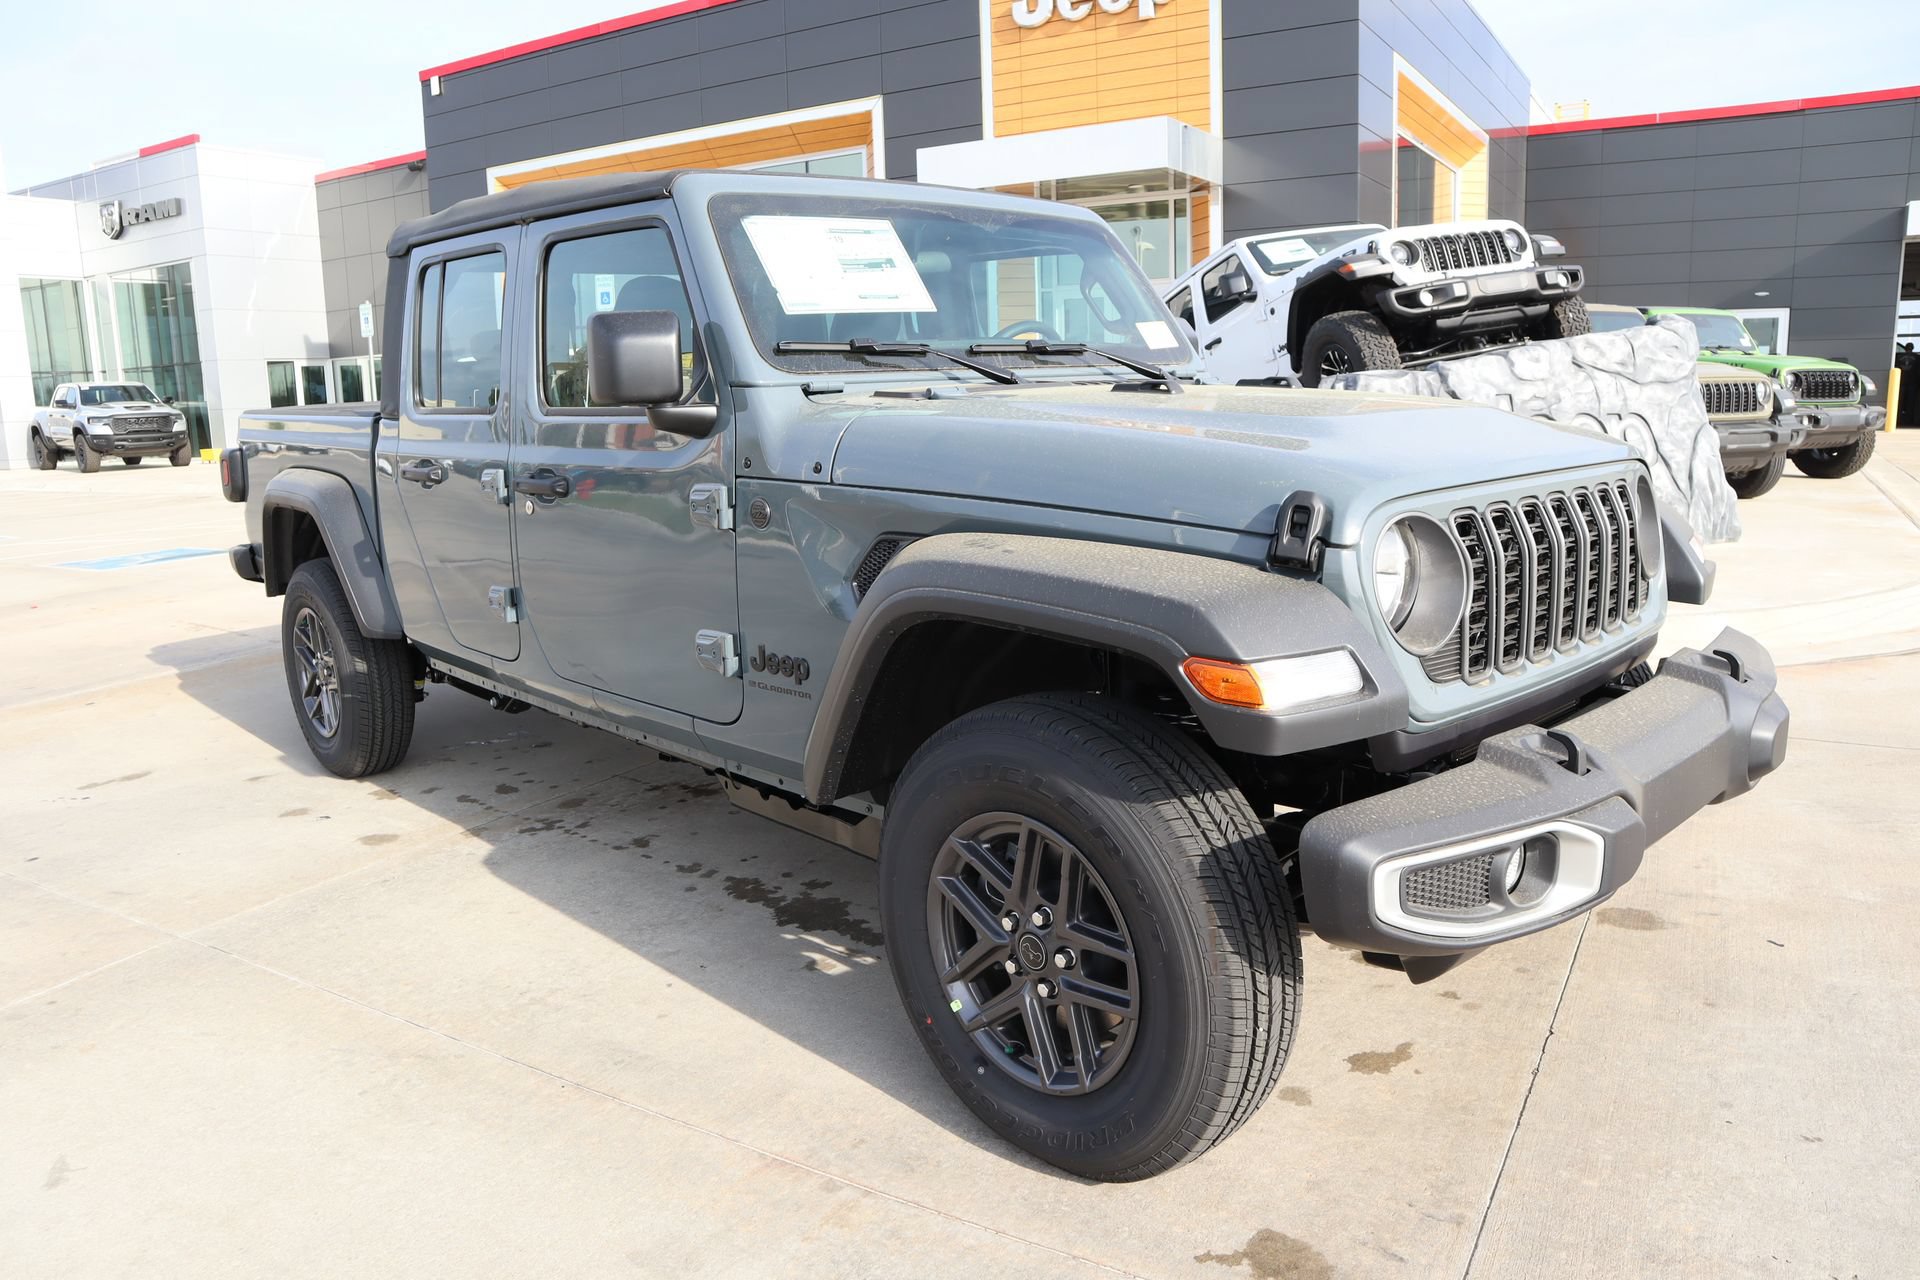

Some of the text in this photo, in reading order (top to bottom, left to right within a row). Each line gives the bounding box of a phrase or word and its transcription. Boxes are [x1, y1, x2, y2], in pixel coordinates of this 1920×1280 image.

[122, 198, 182, 227] RAM
[750, 644, 810, 686] Jeep
[757, 681, 812, 700] GLADIATOR
